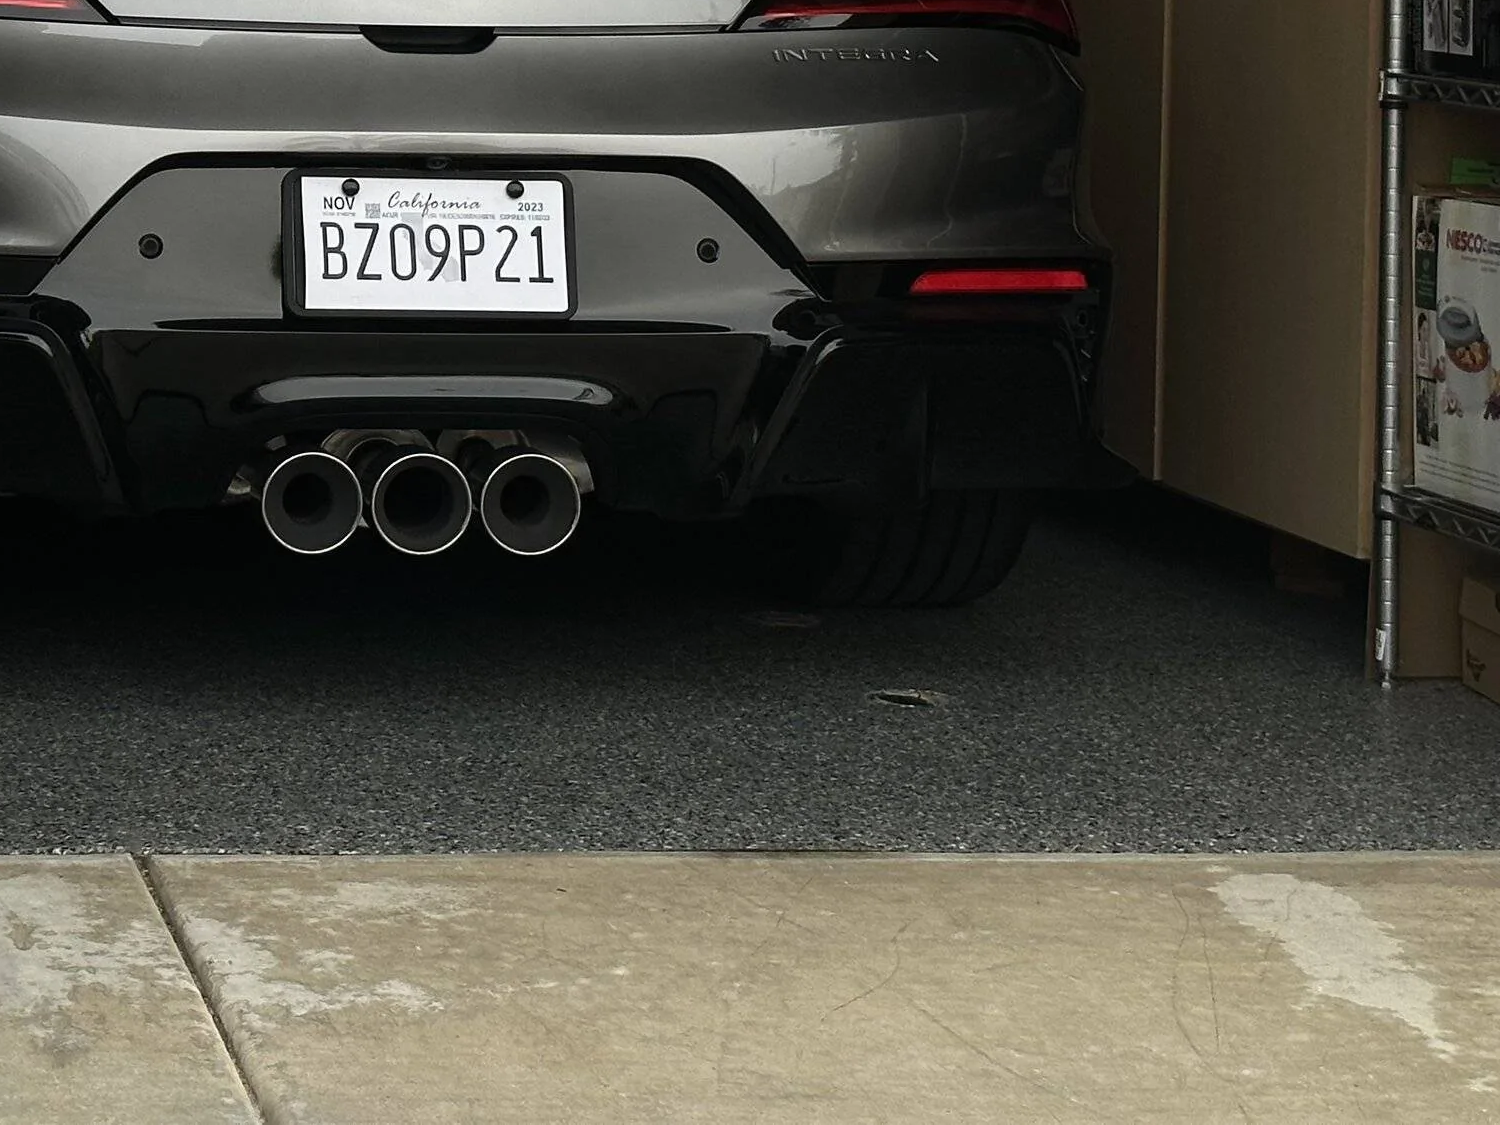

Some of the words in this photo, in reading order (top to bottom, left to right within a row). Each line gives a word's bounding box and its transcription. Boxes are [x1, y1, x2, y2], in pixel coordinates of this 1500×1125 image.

[323, 196, 356, 211] NOV
[387, 190, 482, 218] California
[517, 202, 544, 213] 2023
[320, 221, 554, 284] BZ09P21
[1446, 228, 1483, 255] NESCO
